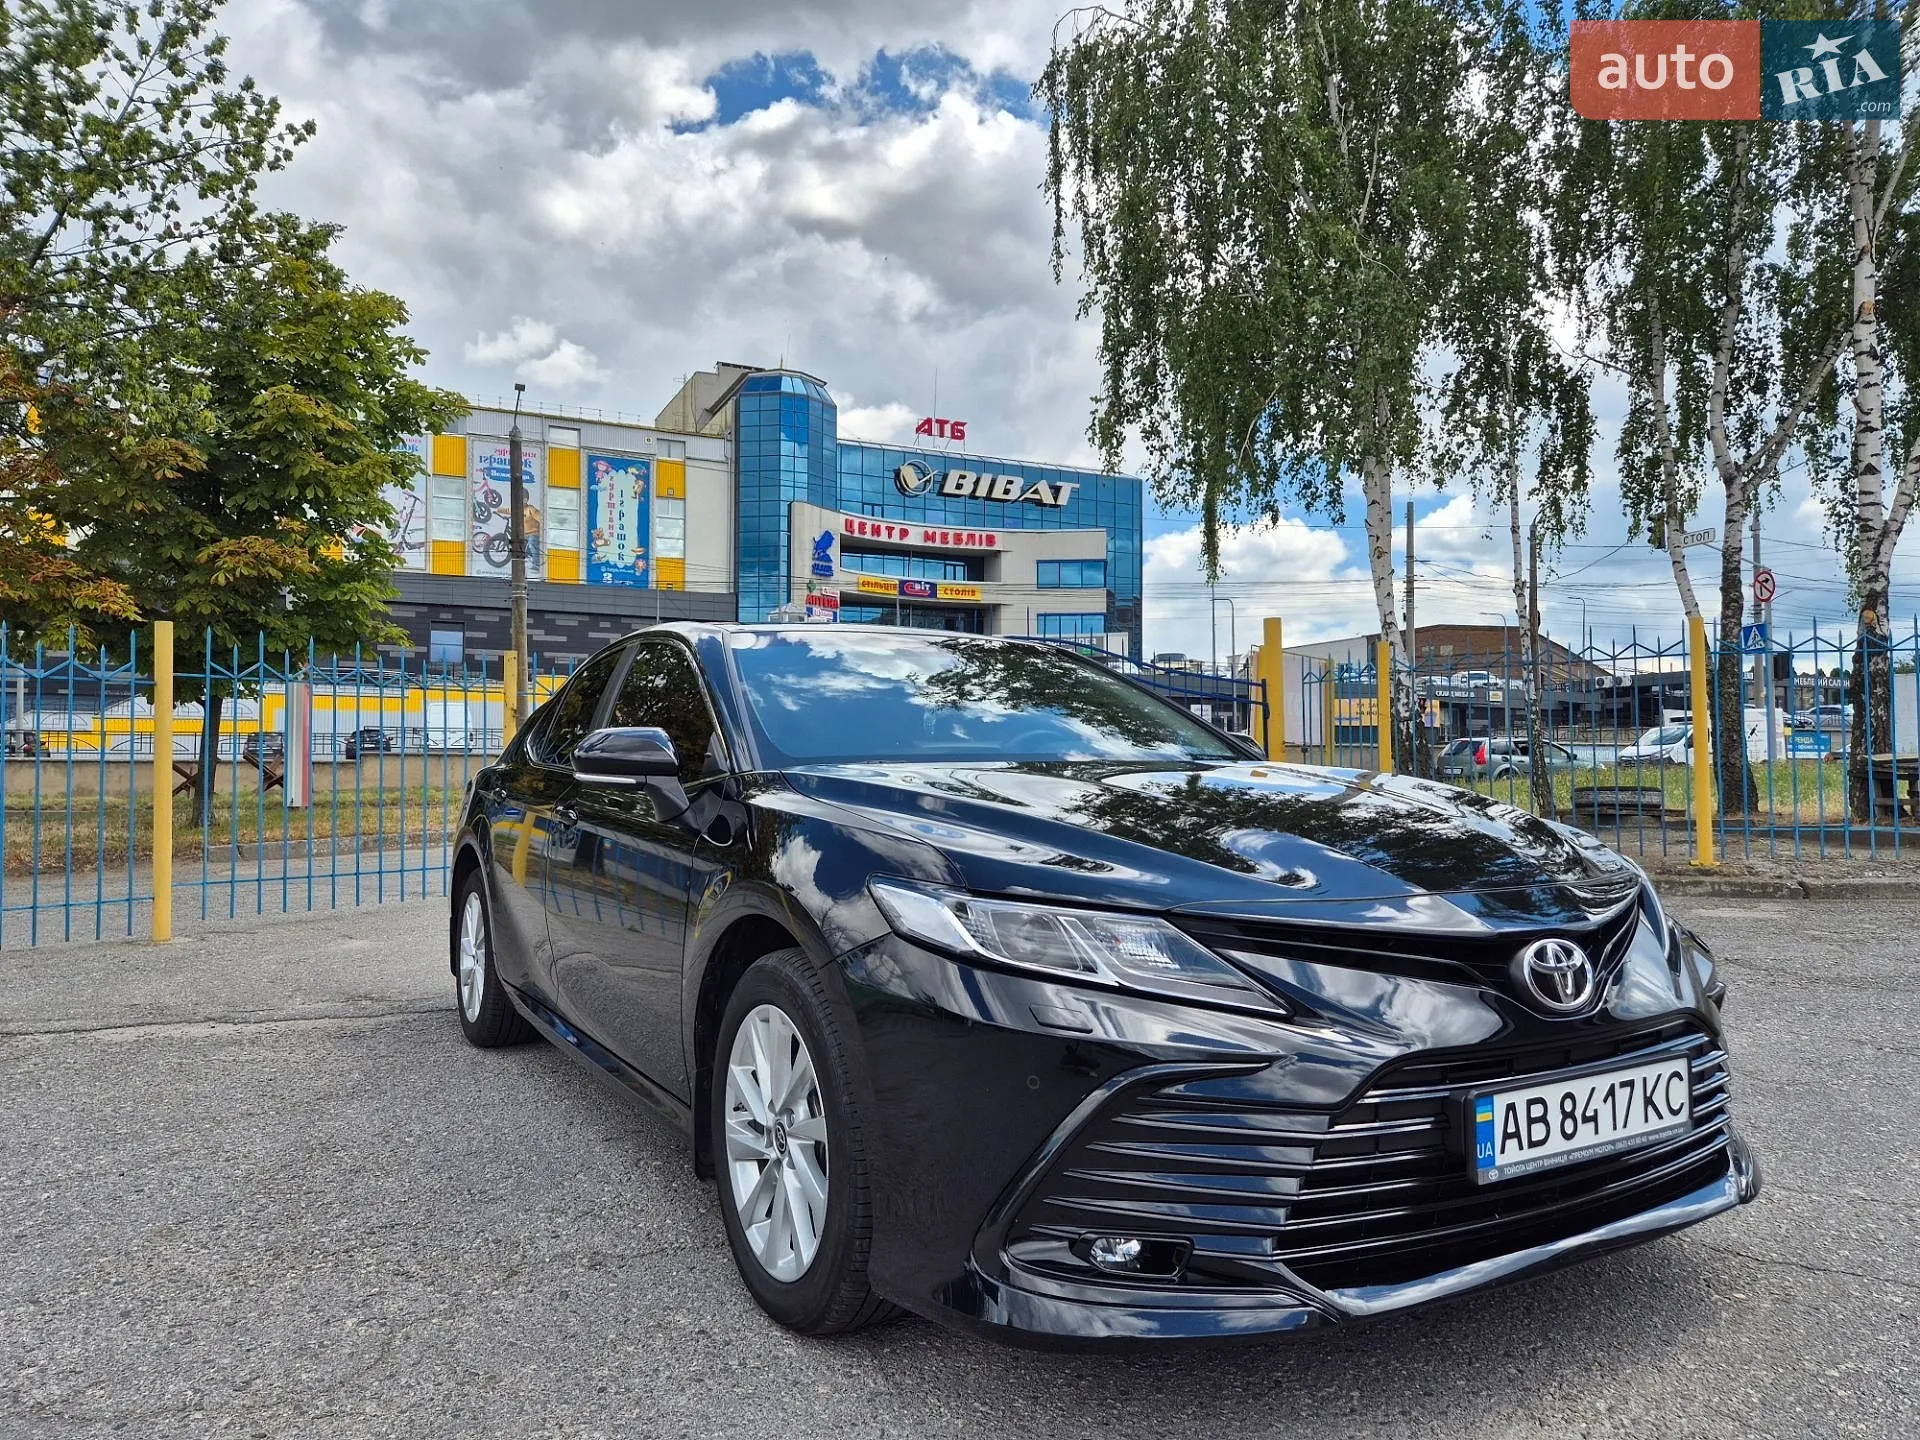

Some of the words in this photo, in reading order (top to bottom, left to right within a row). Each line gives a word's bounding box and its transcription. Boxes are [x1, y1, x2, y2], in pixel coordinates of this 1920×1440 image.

[915, 417, 968, 441] АТБ
[941, 469, 1080, 506] ВІВАТ
[844, 518, 910, 541] ЦЕНТР
[923, 530, 997, 547] МЕБЛІВ
[1683, 531, 1710, 545] СТОП
[1793, 677, 1828, 687] МЕБЛЕИЙ
[1476, 1141, 1494, 1159] UA
